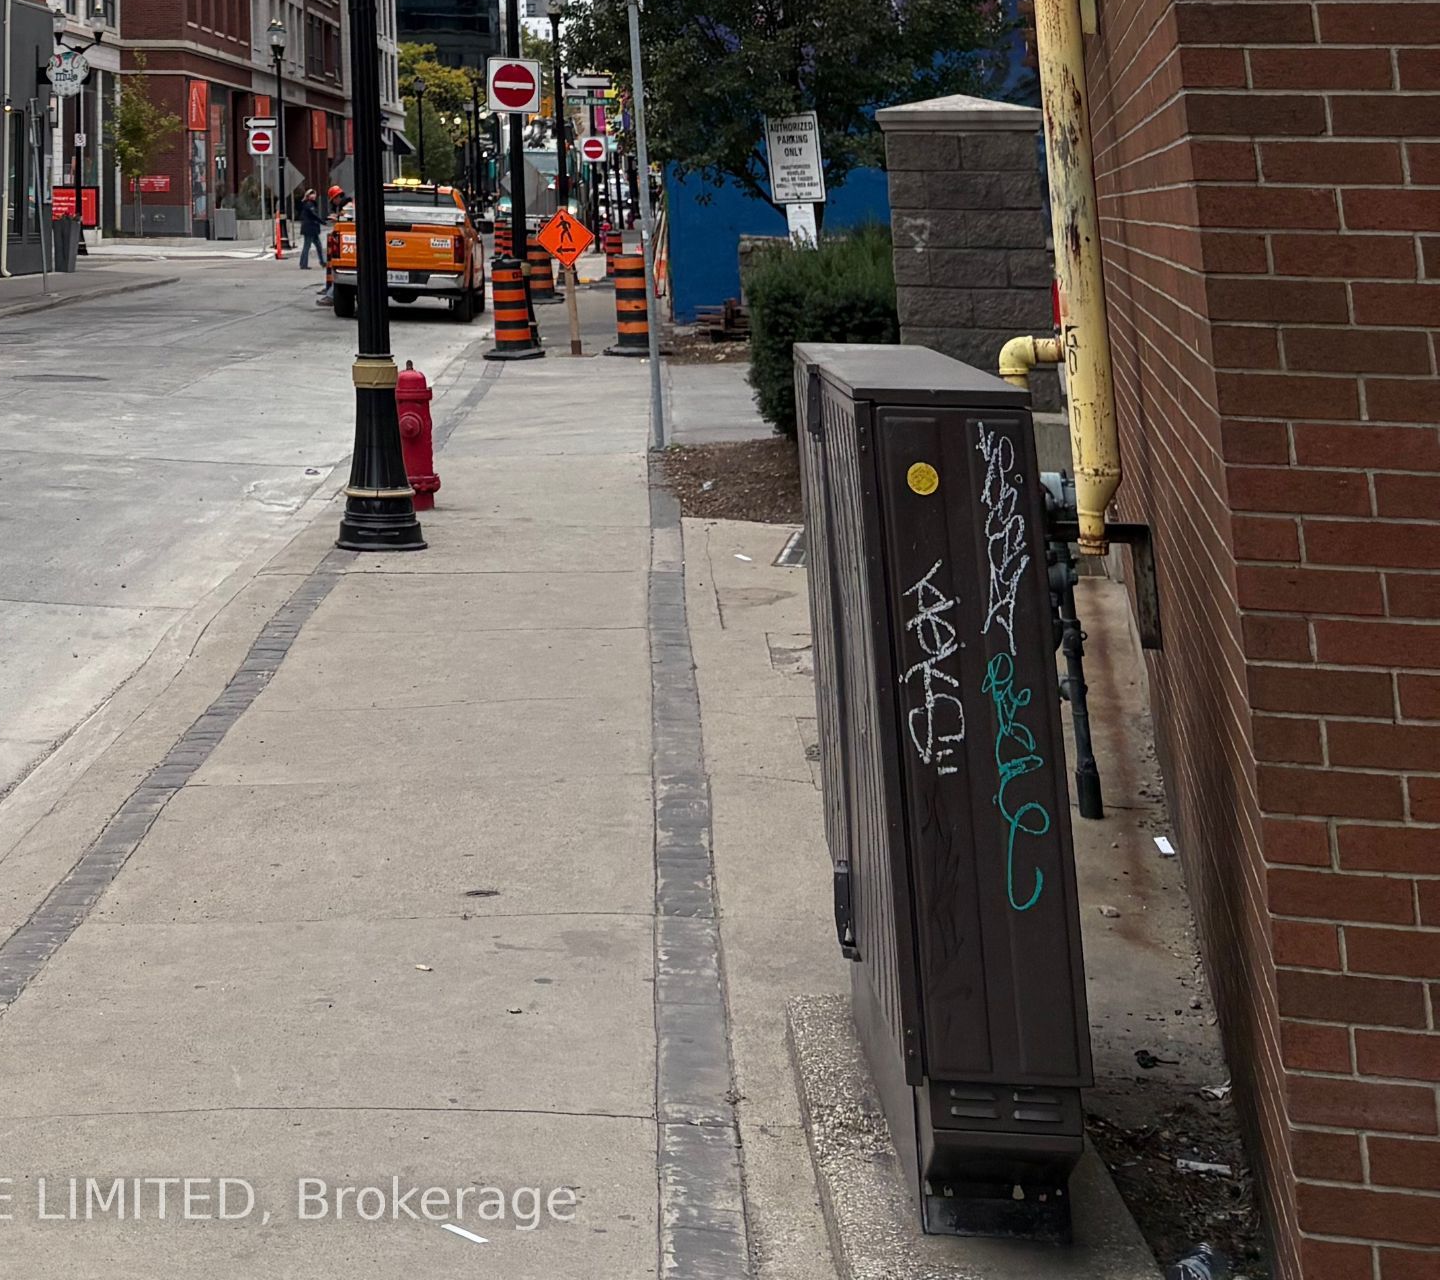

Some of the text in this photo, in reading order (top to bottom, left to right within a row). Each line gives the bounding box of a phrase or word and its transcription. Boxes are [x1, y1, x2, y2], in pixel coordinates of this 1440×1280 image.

[770, 122, 813, 132] AUTHORIZED
[777, 135, 808, 144] PARKING
[784, 147, 802, 157] ONLY
